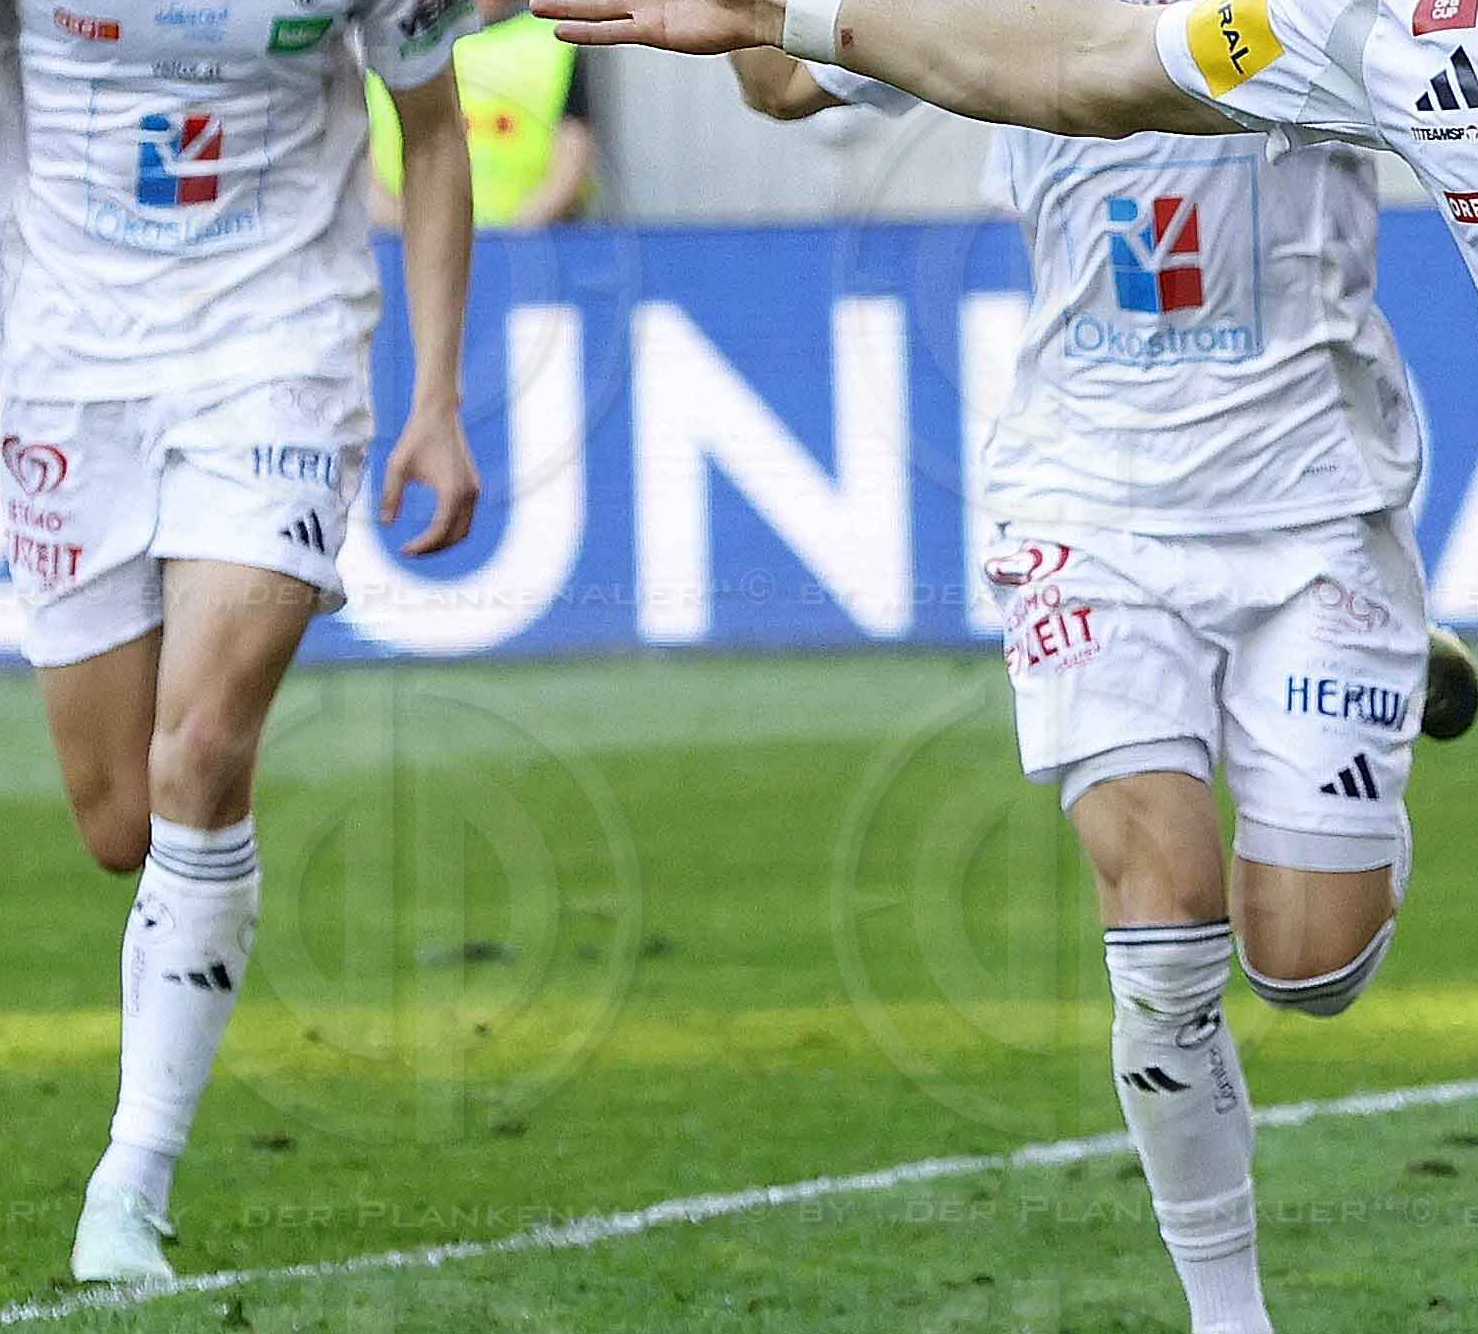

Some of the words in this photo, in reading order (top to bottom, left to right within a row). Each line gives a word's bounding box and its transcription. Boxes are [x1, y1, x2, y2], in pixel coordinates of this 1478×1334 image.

[1432, 8, 1458, 20] CUP
[1073, 315, 1253, 355] Ökostrom
[1287, 675, 1409, 732] HERW
